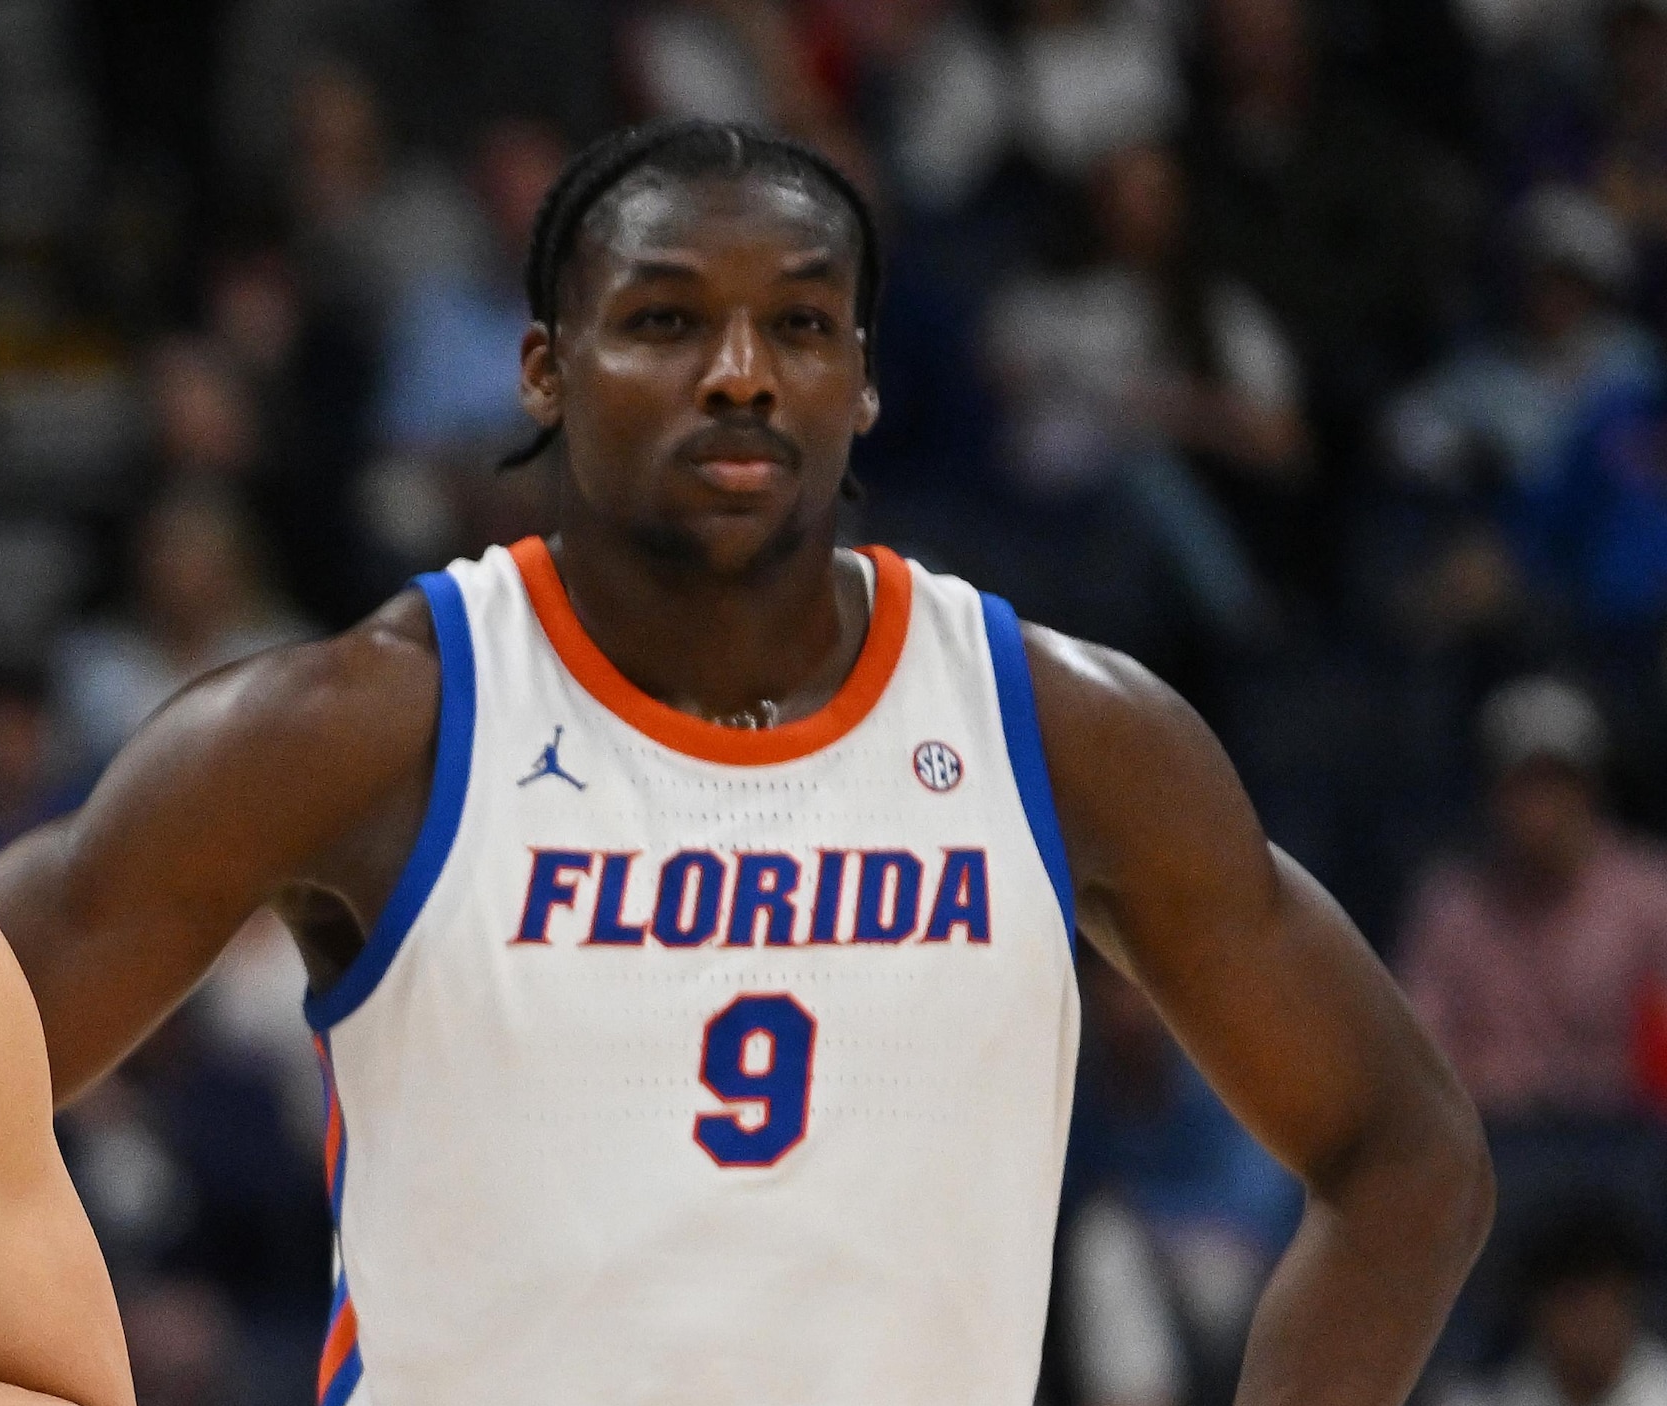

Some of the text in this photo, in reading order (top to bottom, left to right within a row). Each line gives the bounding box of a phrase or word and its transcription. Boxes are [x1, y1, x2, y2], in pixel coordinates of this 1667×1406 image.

[916, 744, 961, 789] SEC
[507, 846, 992, 948] FLORIDA
[692, 991, 818, 1168] 9
